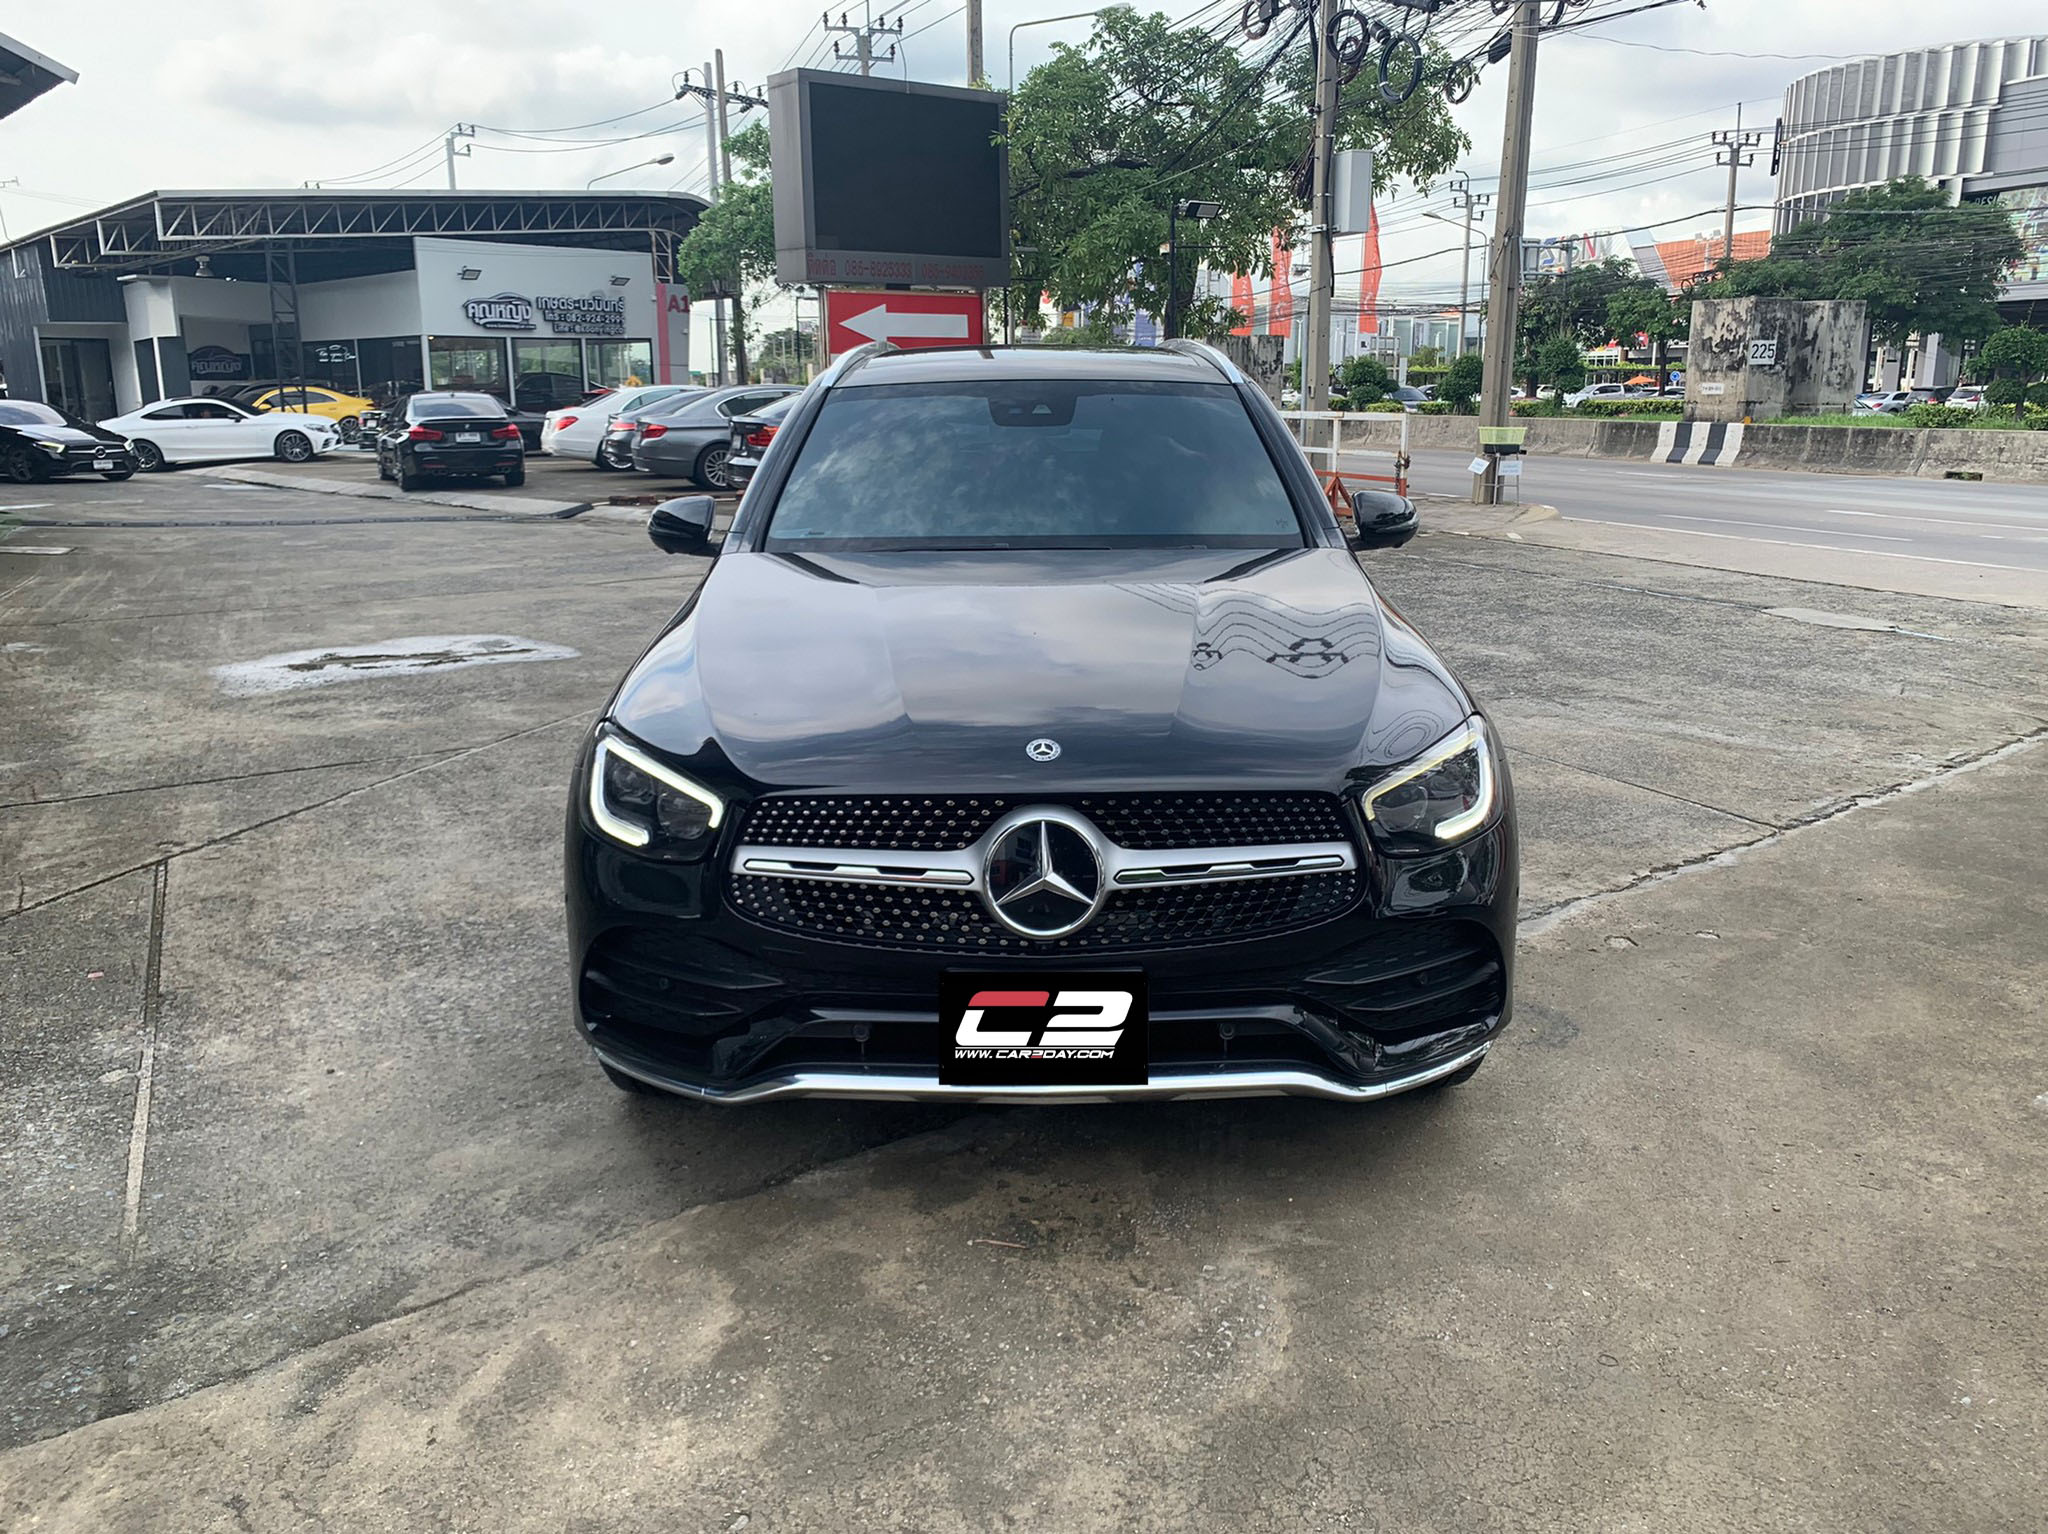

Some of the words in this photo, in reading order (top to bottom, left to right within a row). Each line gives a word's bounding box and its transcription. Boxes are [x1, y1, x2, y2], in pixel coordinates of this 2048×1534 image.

[467, 301, 532, 325] คุณหญิง
[668, 294, 690, 313] A1
[1751, 343, 1776, 359] 225
